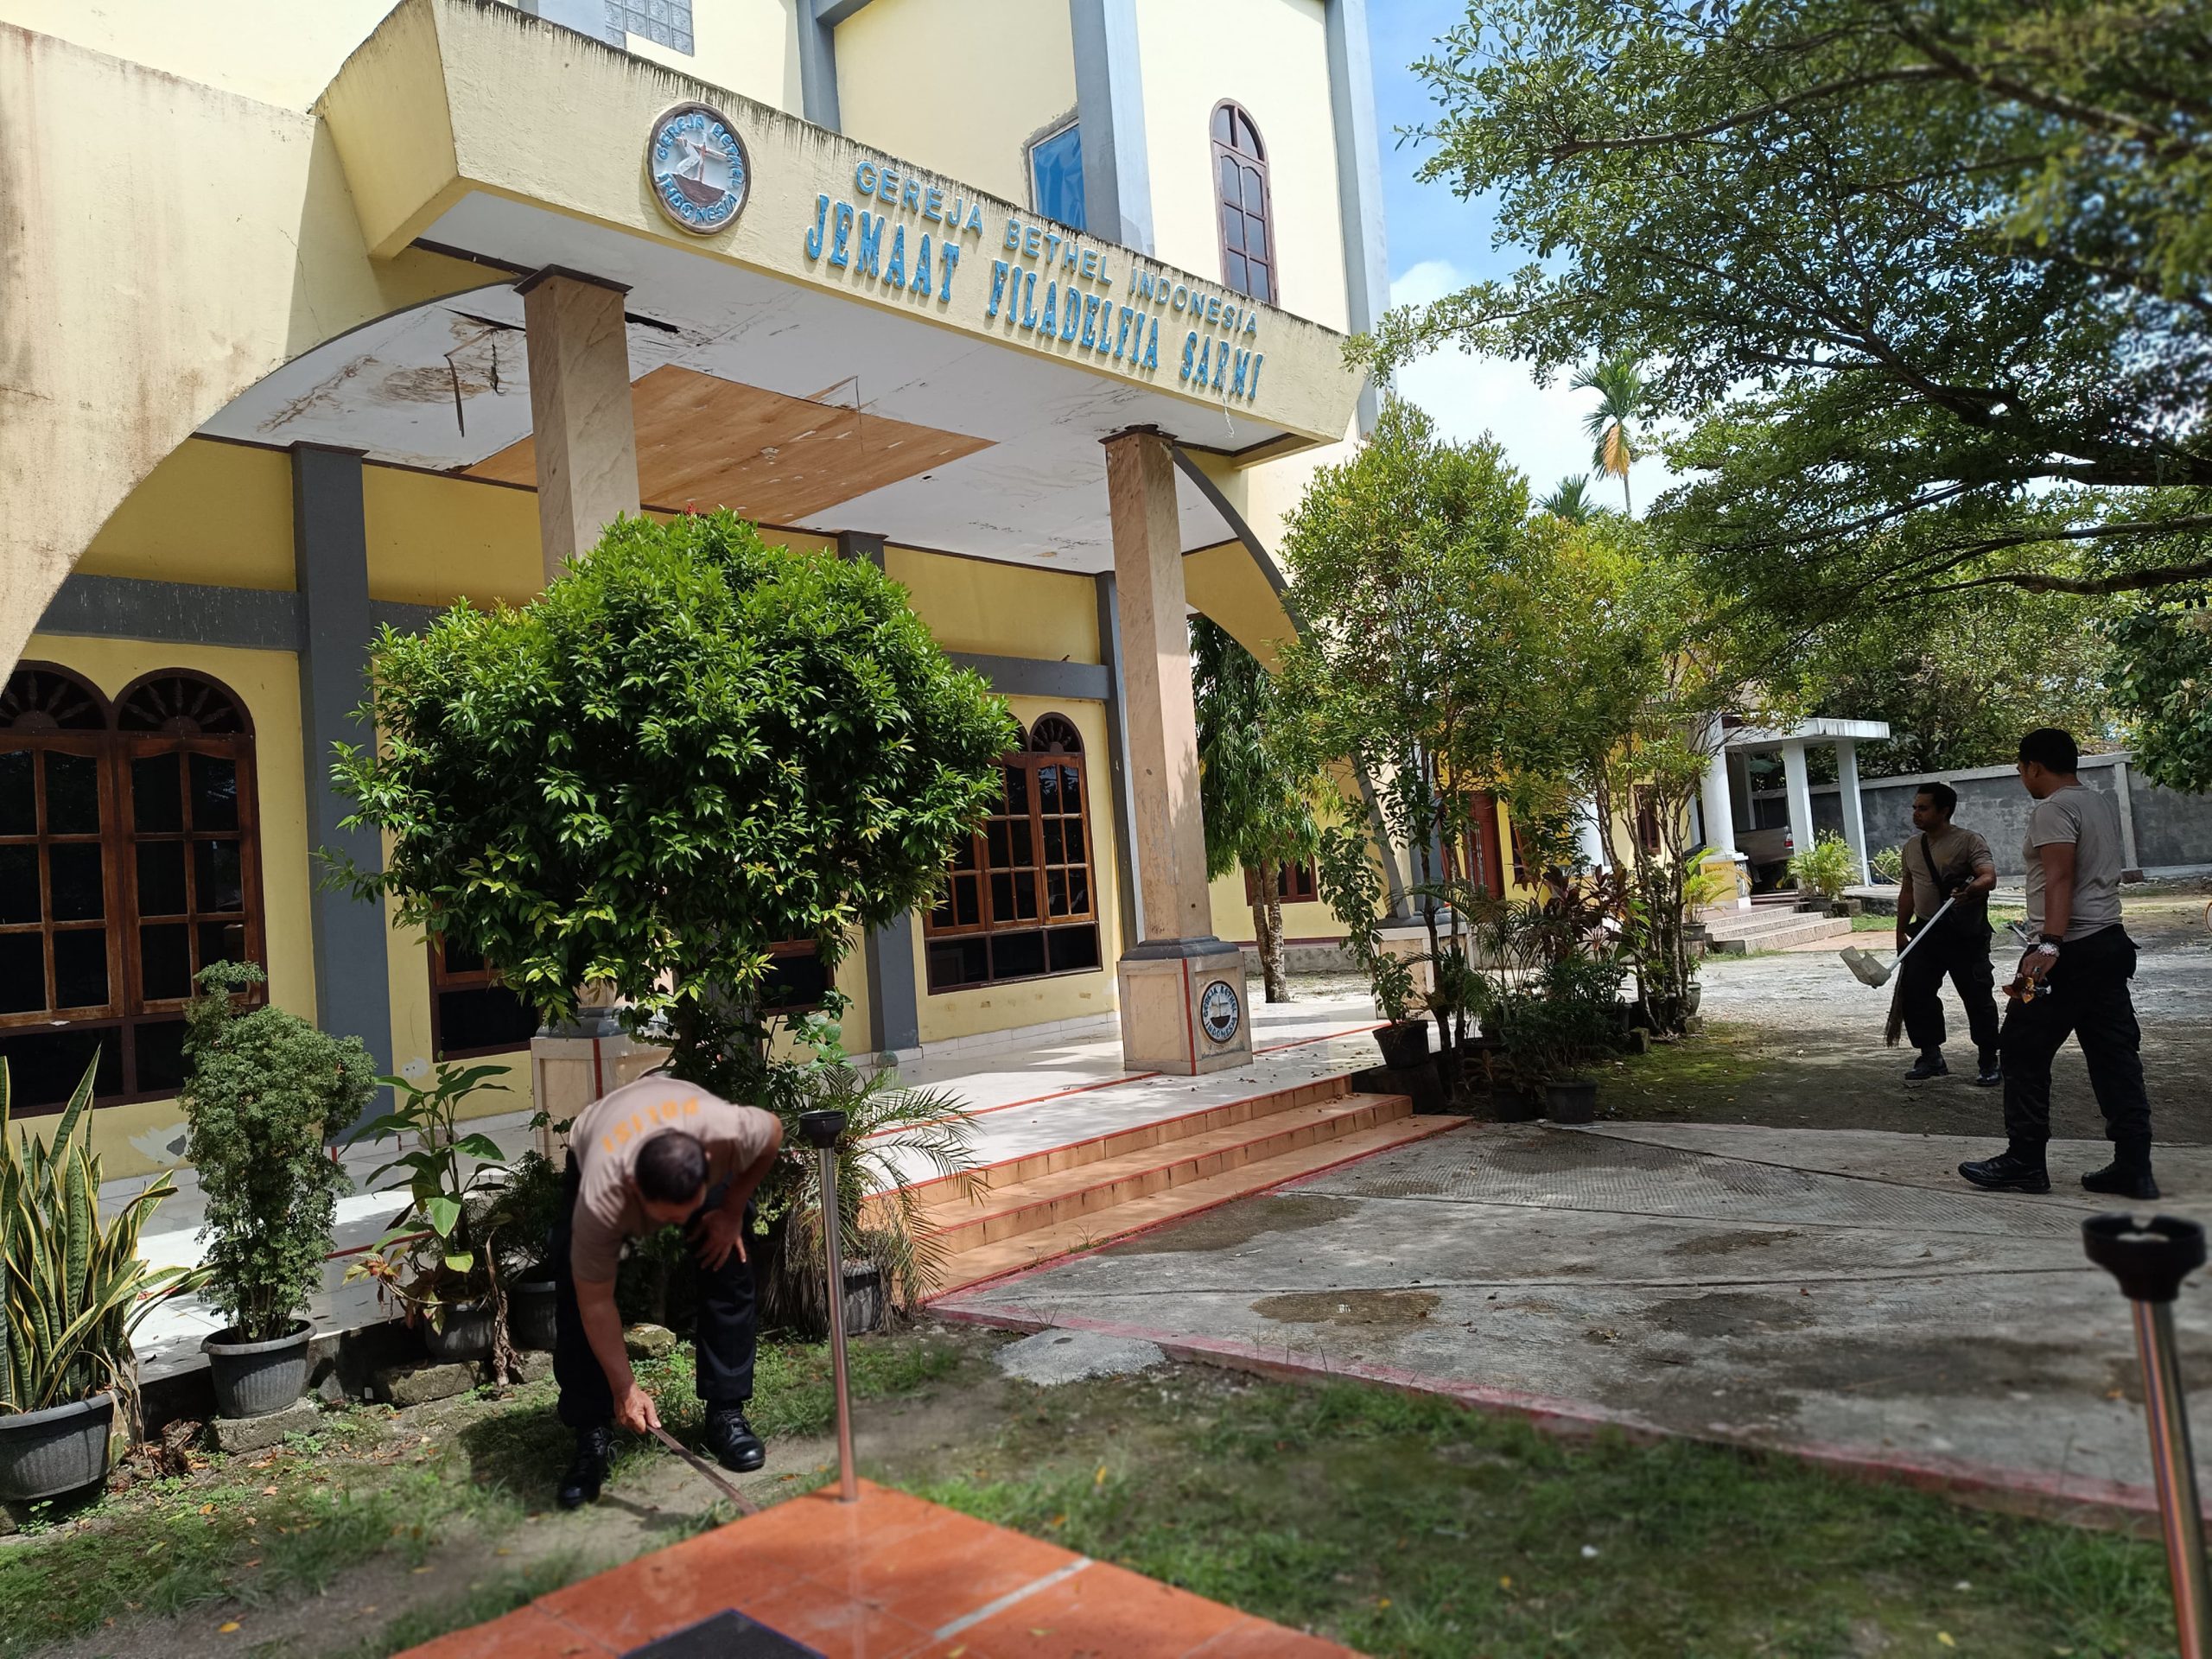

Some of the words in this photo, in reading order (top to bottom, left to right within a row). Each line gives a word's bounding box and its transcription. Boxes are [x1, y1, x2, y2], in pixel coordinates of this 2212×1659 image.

[657, 113, 704, 160] GEREJA
[710, 122, 744, 189] BETHEL
[656, 172, 737, 222] INDONESIA
[855, 160, 984, 238] GEREJA
[1004, 218, 1113, 286] BETHEL
[1129, 267, 1258, 339] INDONESIA
[805, 193, 960, 304] JEMAAT
[986, 257, 1160, 372] FILADELFIA
[1180, 331, 1264, 401] SARMI
[1204, 988, 1218, 1017] GEREJA
[601, 1096, 700, 1153] POLISI
